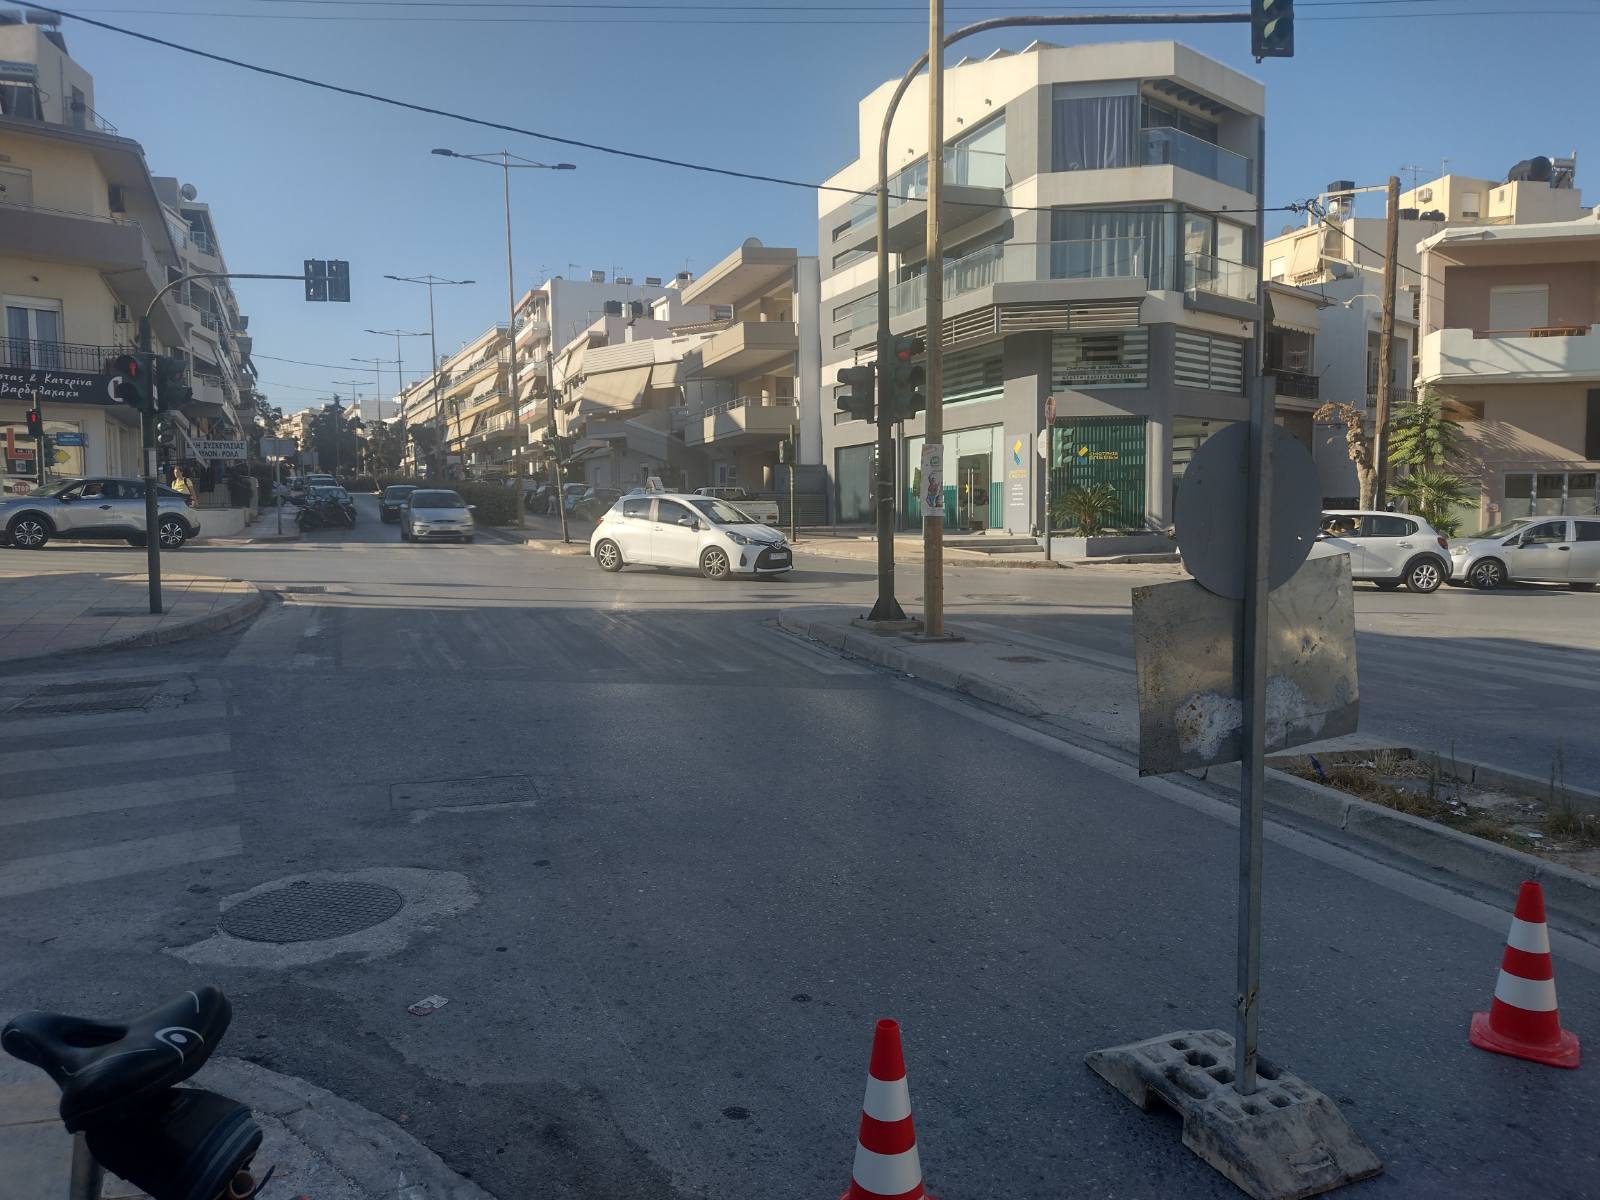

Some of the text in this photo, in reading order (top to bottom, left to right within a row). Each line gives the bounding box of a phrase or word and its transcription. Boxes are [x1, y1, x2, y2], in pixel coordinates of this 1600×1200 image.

[29, 373, 38, 382] &
[44, 372, 93, 390] Κατερίνα
[14, 485, 29, 493] STOP
